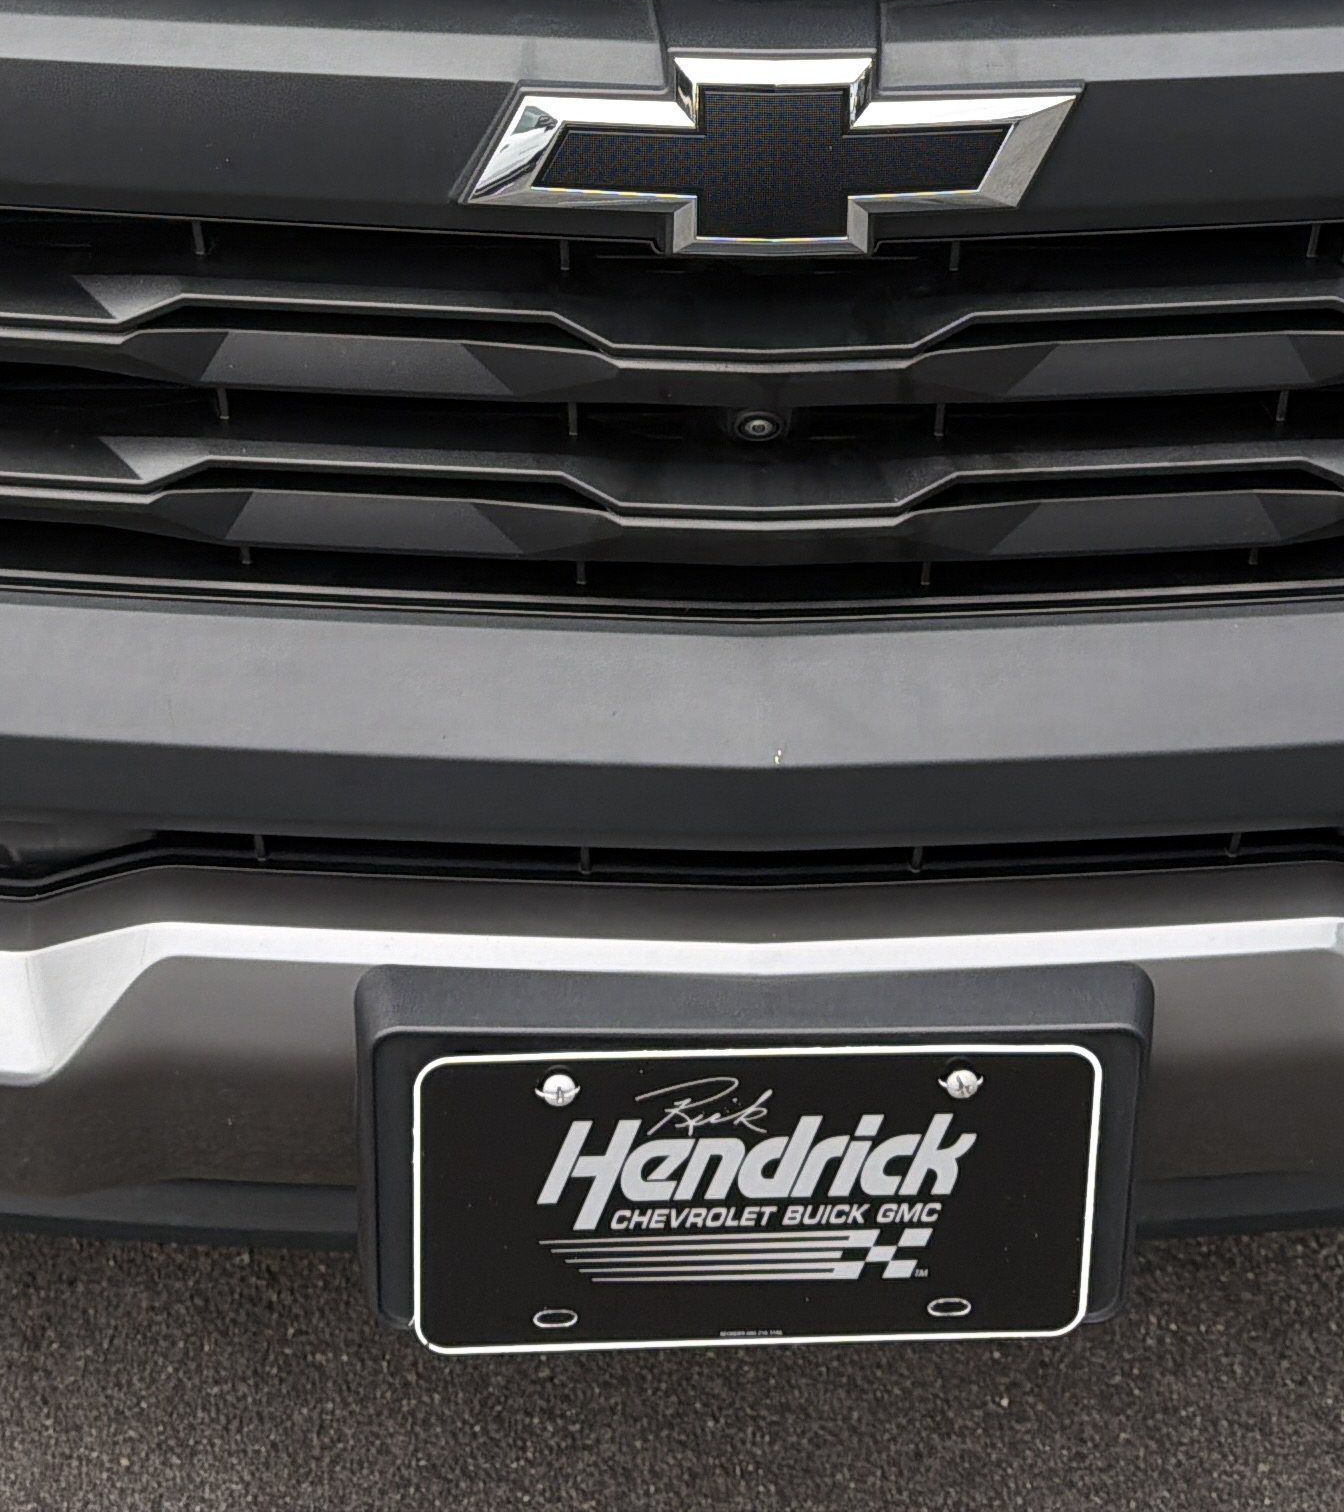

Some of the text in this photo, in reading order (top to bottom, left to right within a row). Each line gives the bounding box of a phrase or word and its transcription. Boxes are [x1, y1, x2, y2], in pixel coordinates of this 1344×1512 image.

[537, 1113, 977, 1231] Hendrick
[610, 1201, 943, 1230] CHEVROLET BUICK GMC
